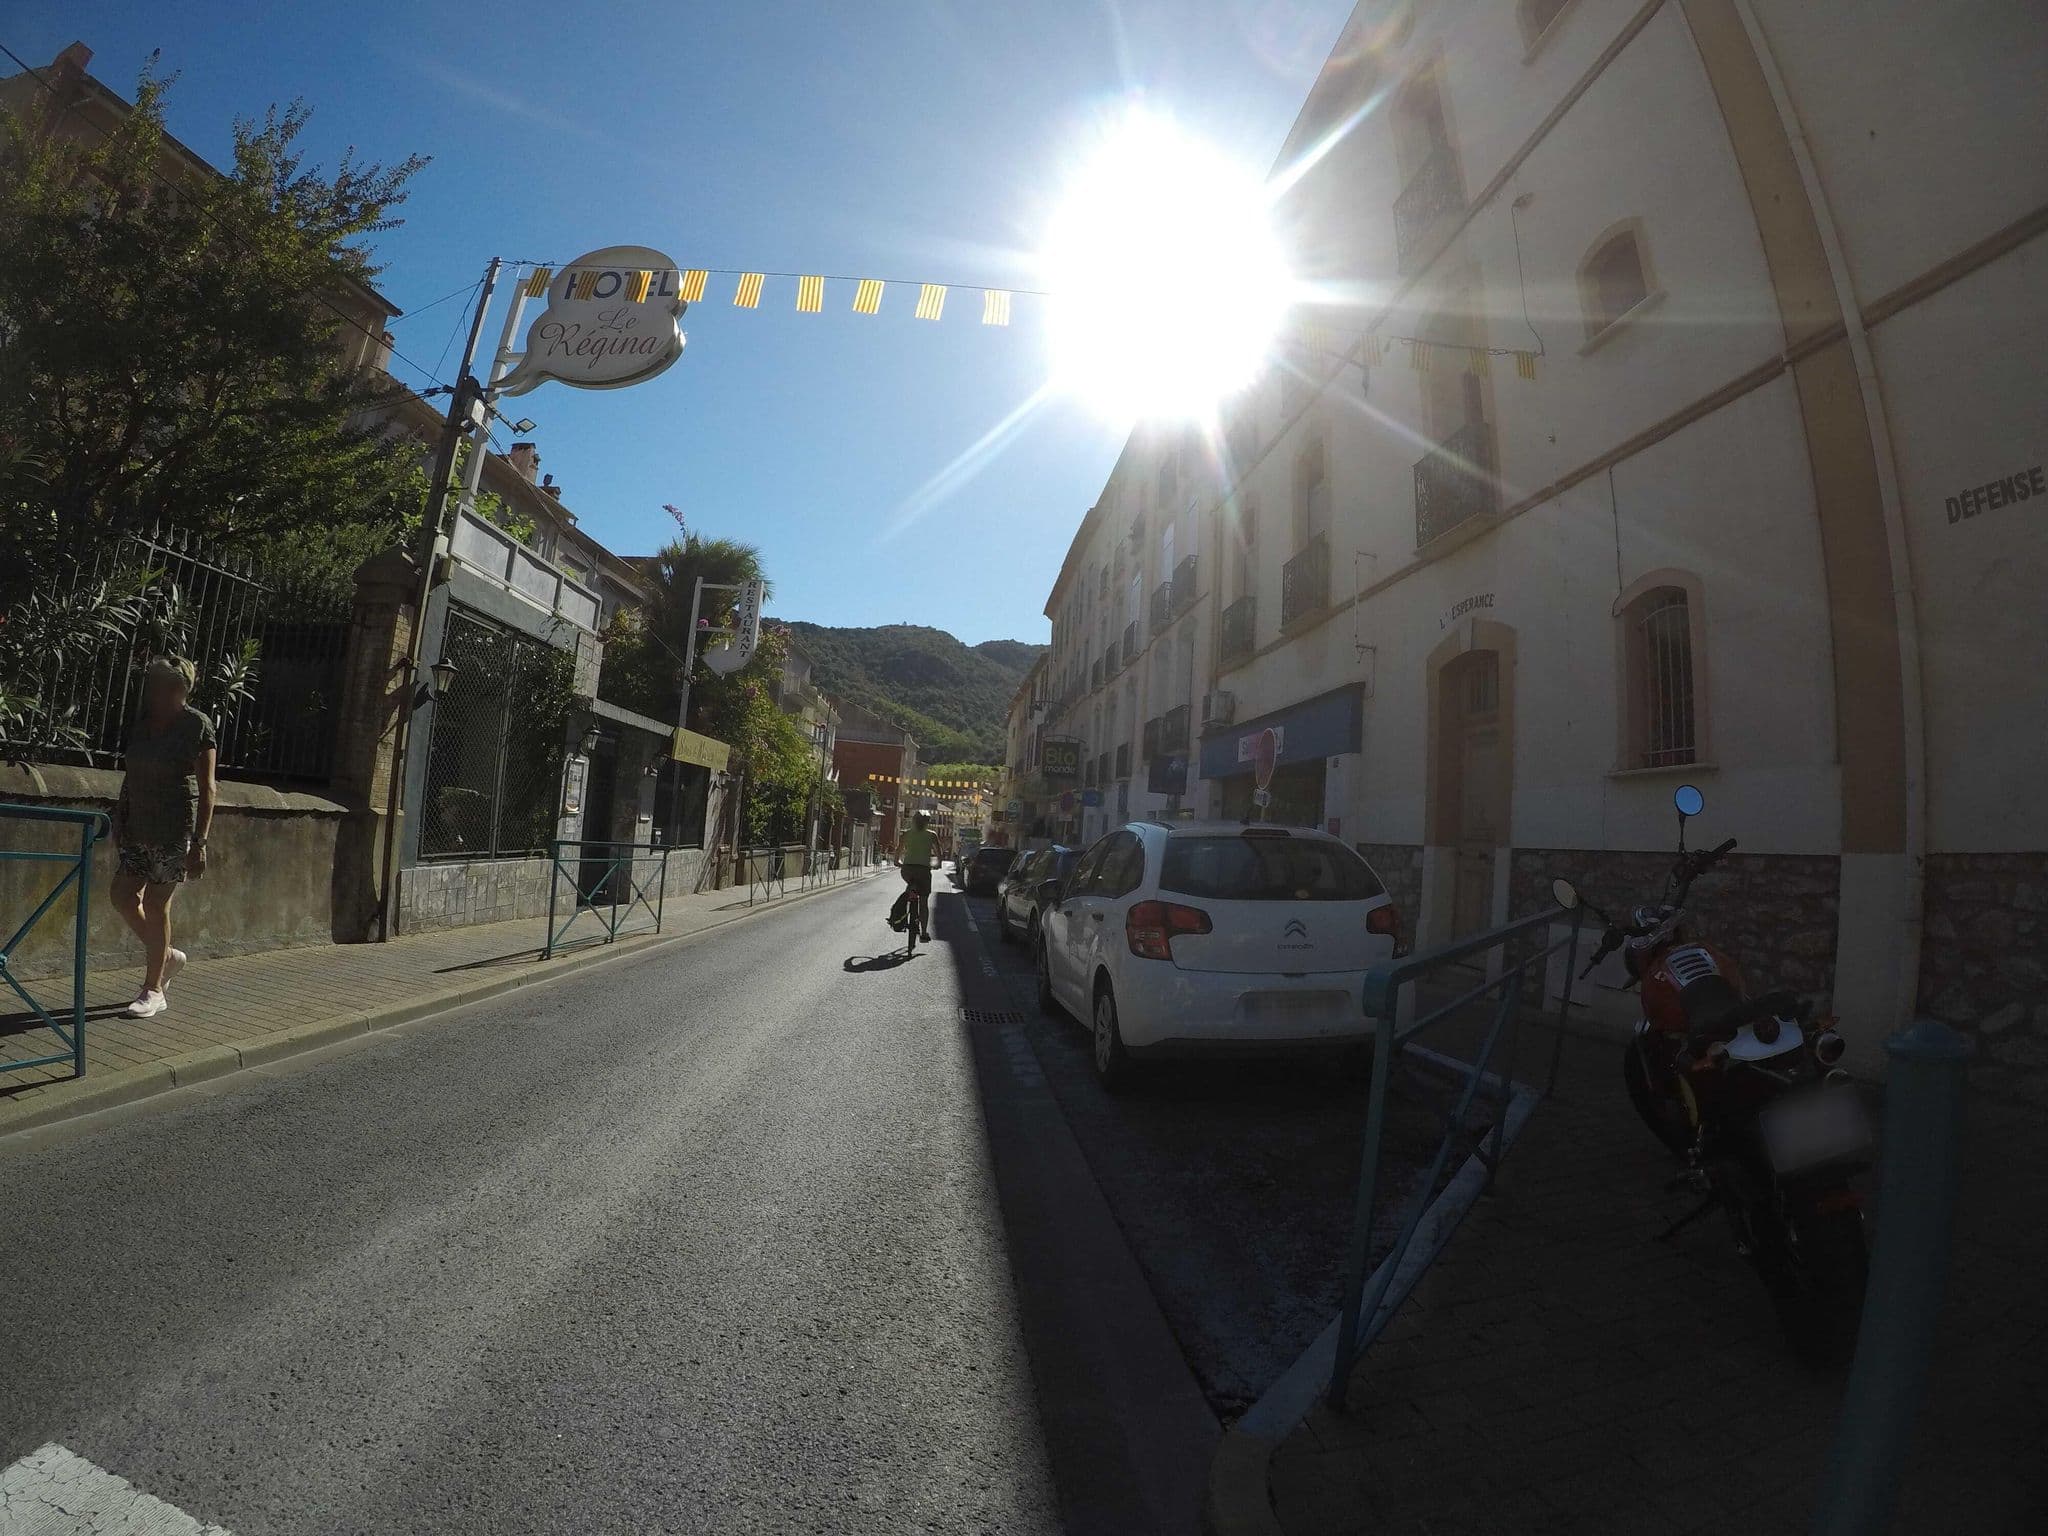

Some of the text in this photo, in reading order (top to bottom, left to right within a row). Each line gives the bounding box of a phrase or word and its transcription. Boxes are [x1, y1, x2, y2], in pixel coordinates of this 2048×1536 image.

[564, 271, 673, 300] HOEL
[598, 308, 639, 330] Le
[540, 323, 663, 369] Régina
[1944, 465, 2047, 525] DÉFENSE
[739, 581, 757, 658] RESTAURANT
